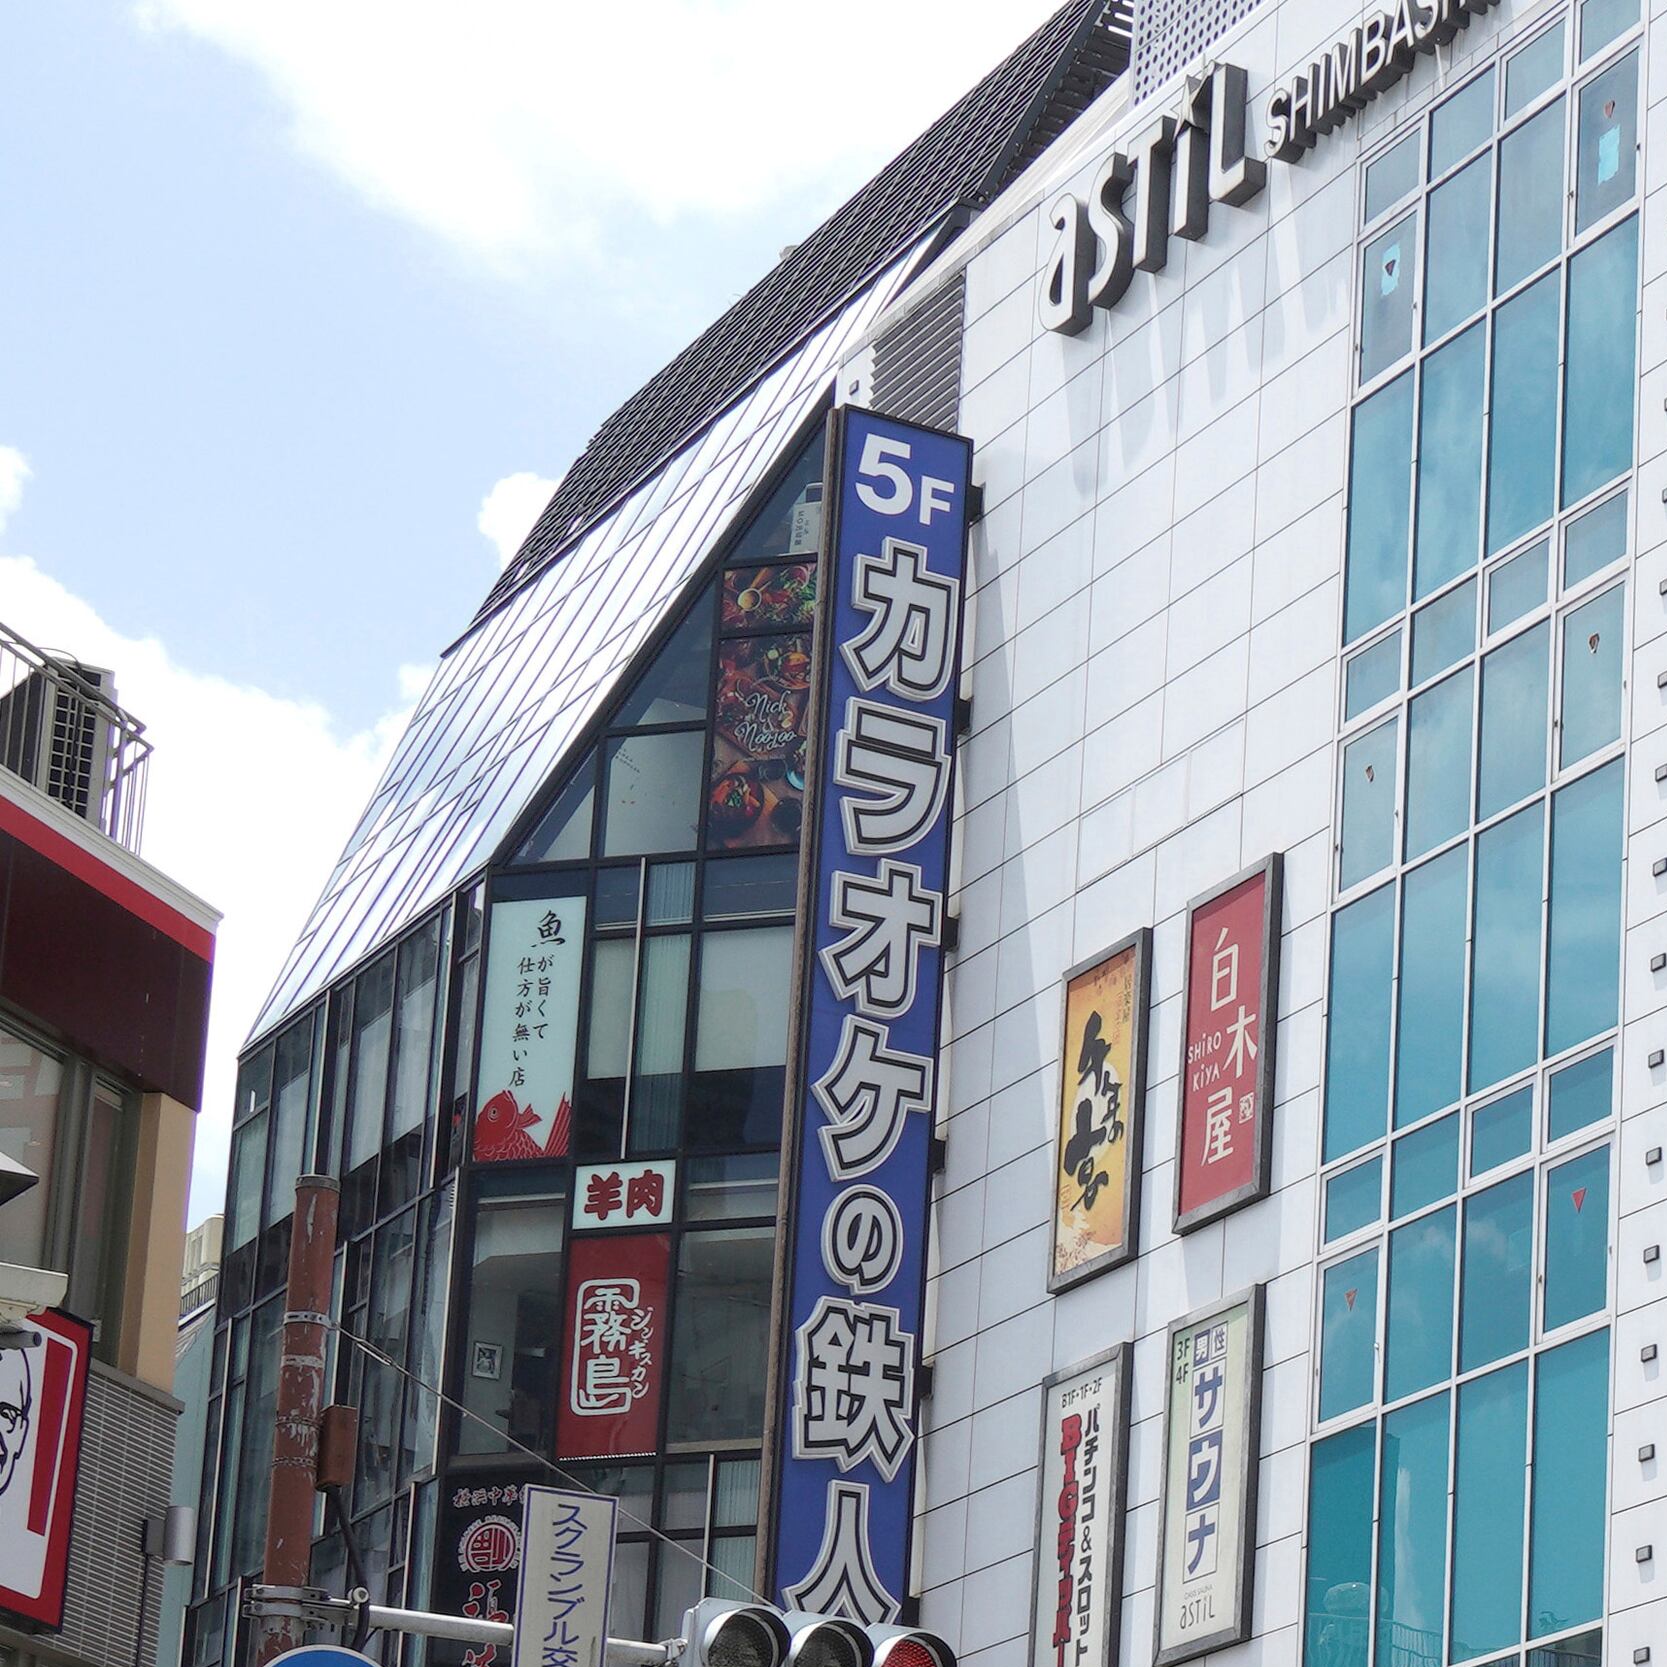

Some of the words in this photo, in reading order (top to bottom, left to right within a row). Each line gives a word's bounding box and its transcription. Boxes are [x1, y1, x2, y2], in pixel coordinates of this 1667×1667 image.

[853, 433, 955, 527] 5F
[784, 538, 963, 1624] カラオケの鉄人
[1201, 927, 1258, 1167] 白木屋
[584, 1169, 665, 1221] 羊肉
[580, 1284, 637, 1408] 霧島
[1175, 1361, 1189, 1386] 4F
[1176, 1336, 1191, 1361] 3F
[1186, 1367, 1224, 1575] サウナ
